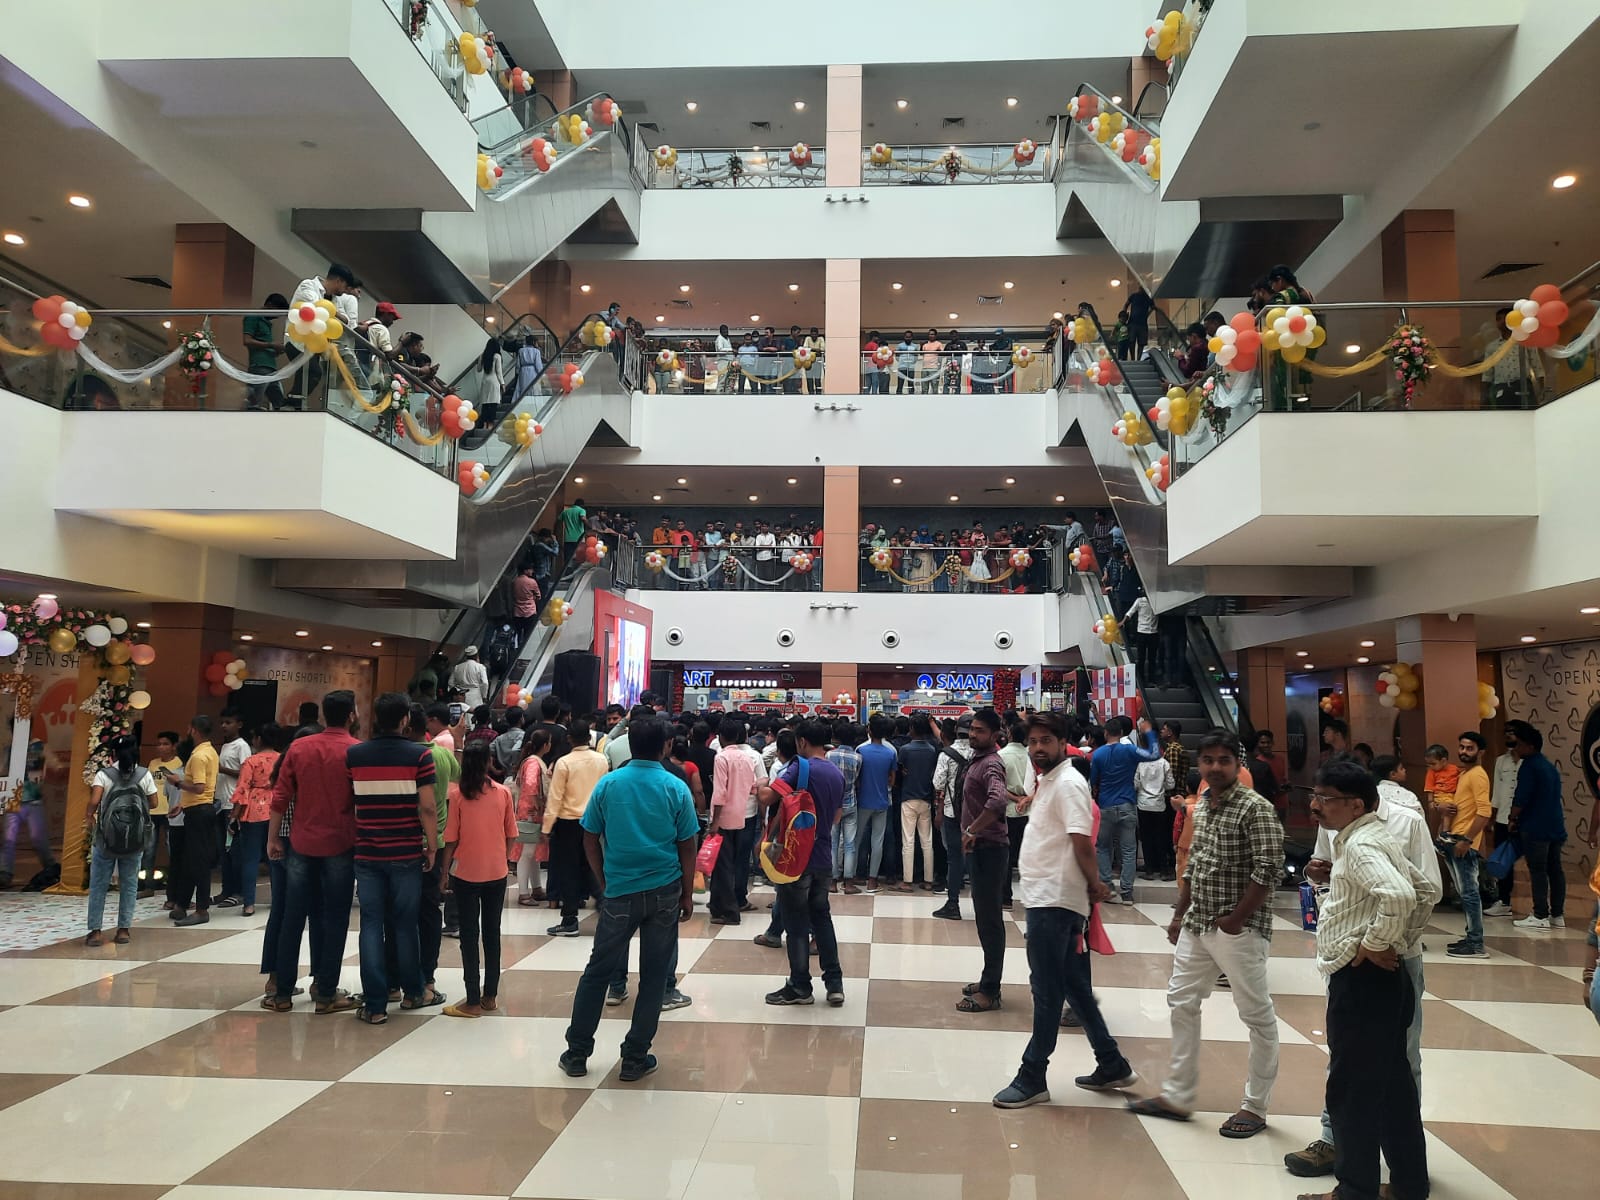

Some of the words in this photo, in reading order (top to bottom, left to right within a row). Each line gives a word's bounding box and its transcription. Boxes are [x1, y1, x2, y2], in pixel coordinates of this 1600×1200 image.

[267, 669, 293, 681] OPEN
[936, 674, 994, 690] SMART
[1554, 670, 1591, 685] OPEN
[697, 694, 707, 710] 9
